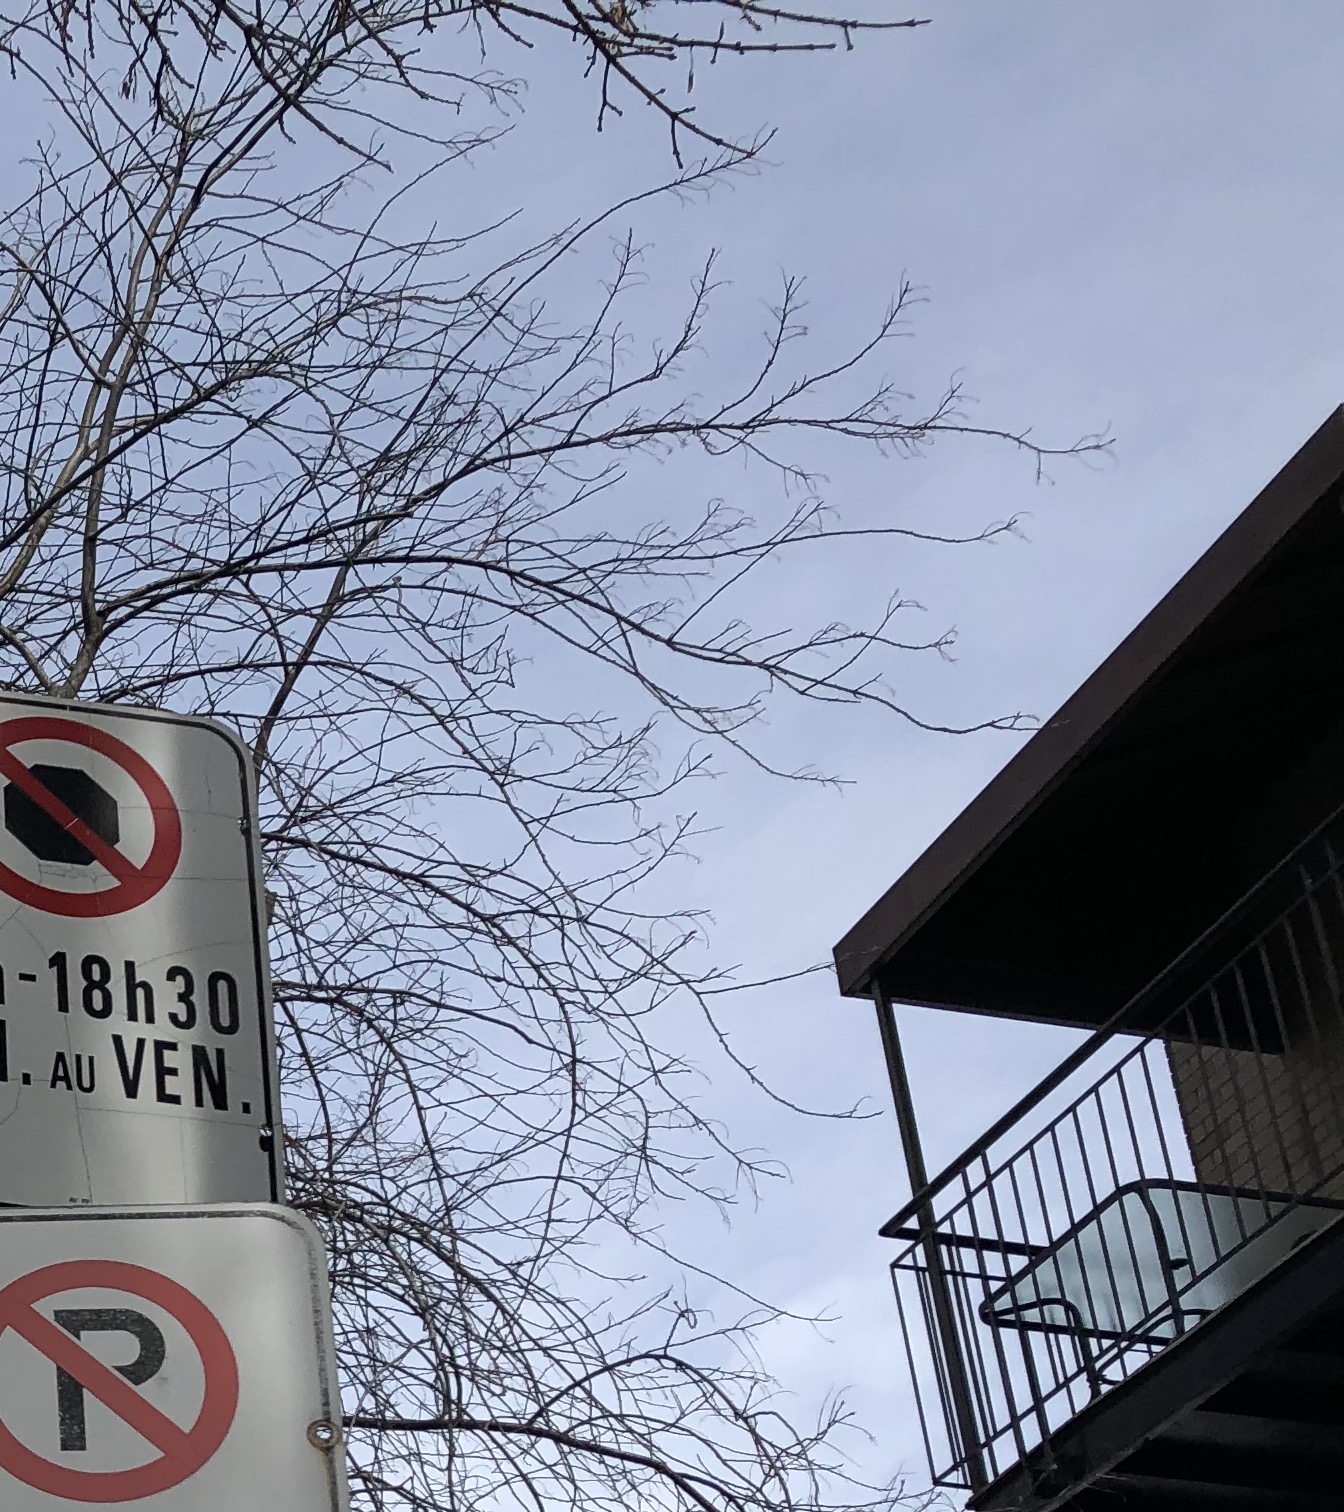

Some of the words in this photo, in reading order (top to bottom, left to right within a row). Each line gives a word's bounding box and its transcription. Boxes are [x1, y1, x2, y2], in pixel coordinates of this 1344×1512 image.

[50, 1050, 96, 1094] AU
[111, 1033, 251, 1114] VEN.
[53, 1308, 165, 1452] P
